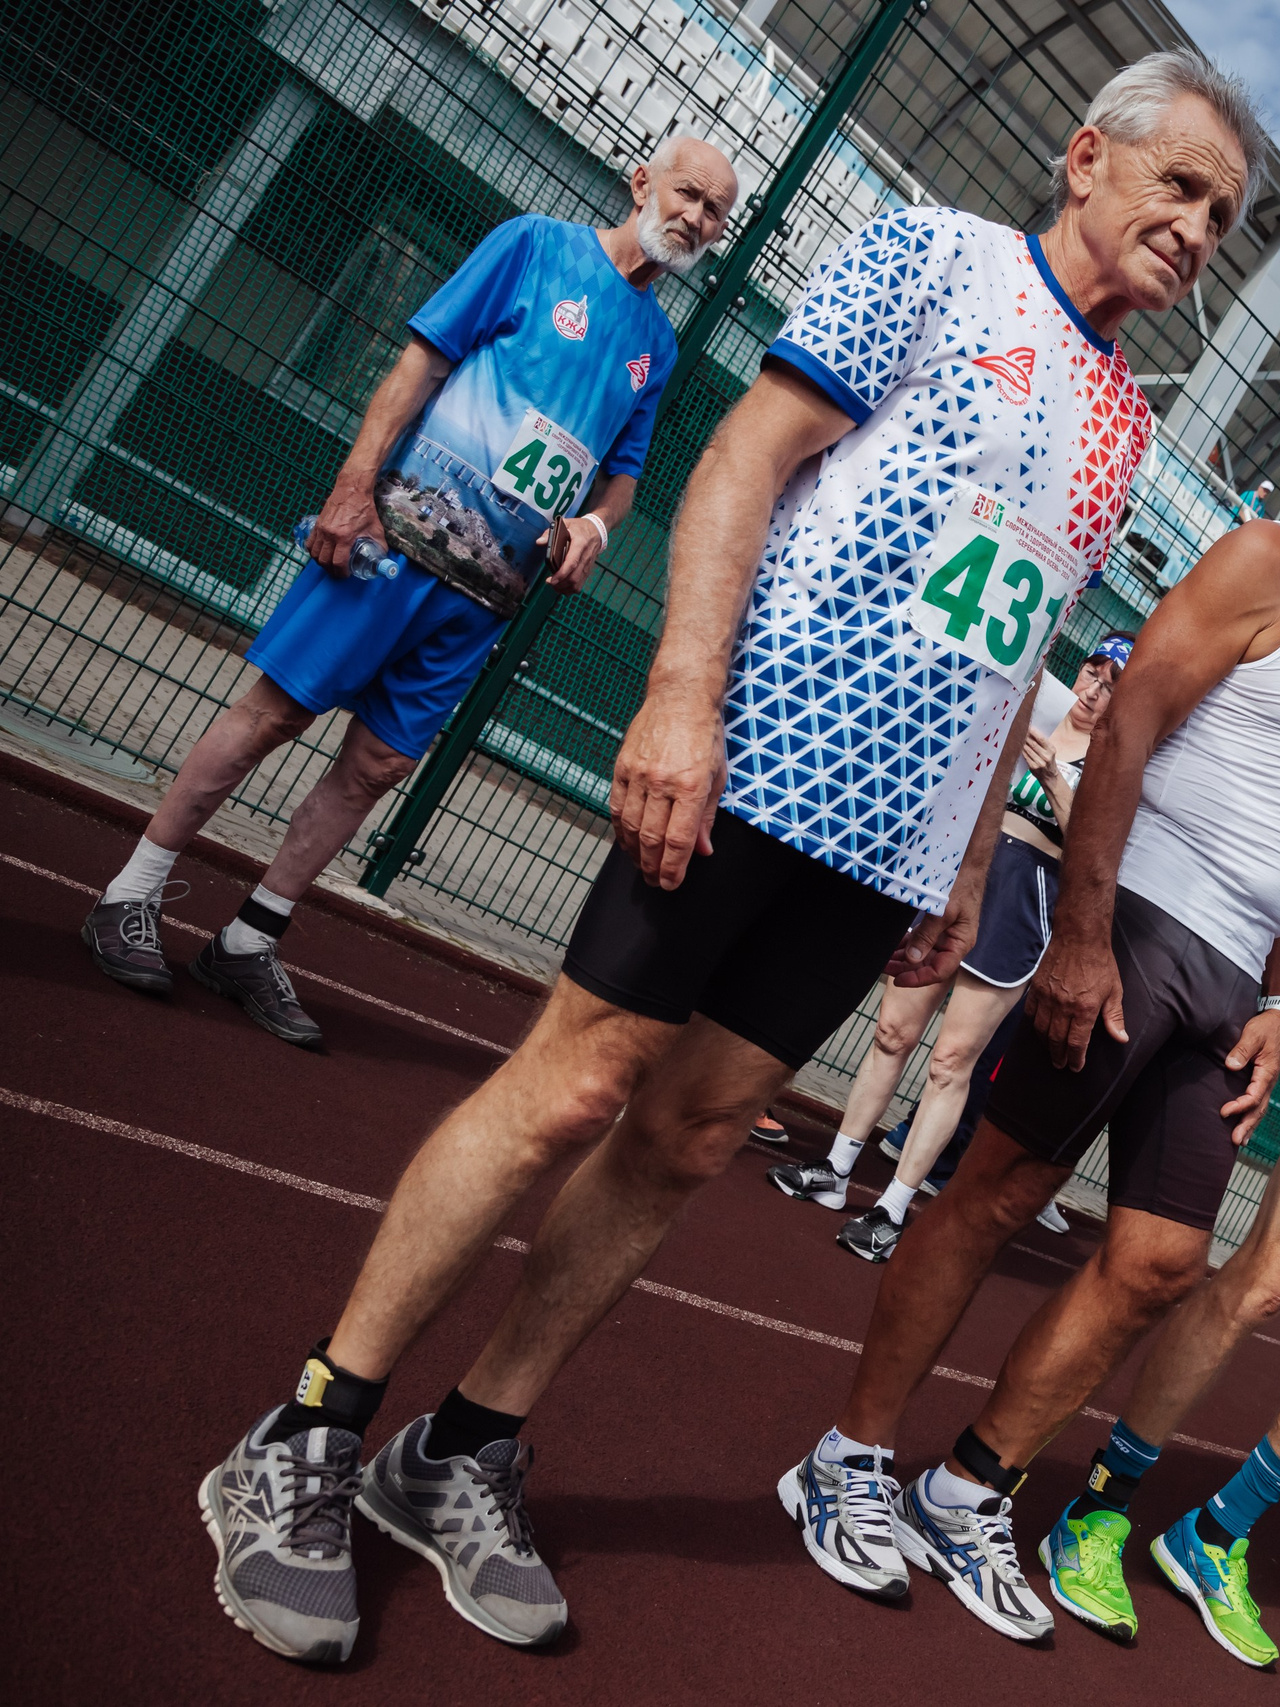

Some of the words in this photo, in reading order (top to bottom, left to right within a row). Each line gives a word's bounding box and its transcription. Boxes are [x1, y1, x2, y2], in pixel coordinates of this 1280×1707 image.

[557, 315, 586, 338] КЖД
[503, 438, 583, 520] 436
[921, 534, 1068, 684] 431
